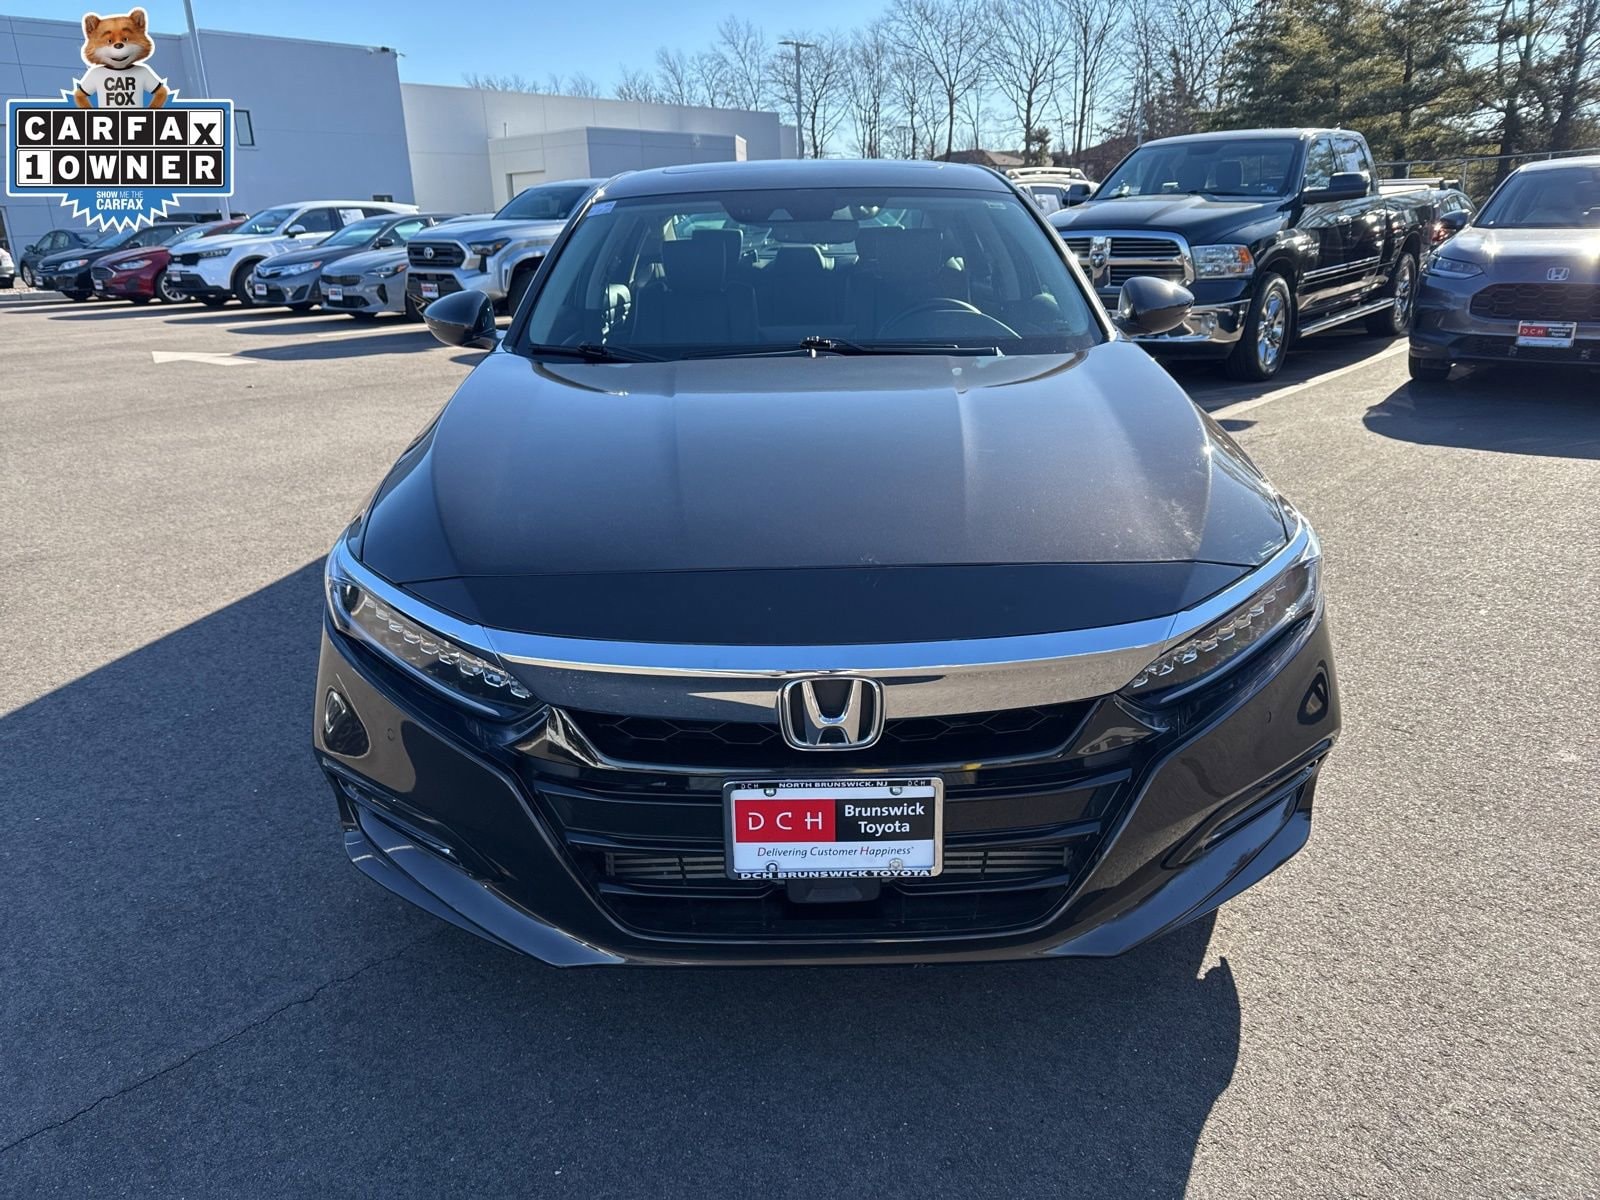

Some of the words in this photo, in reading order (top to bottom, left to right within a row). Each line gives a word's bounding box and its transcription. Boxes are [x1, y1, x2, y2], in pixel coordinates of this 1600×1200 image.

[844, 802, 925, 817] Brunswick
[858, 820, 910, 837] Toyota
[757, 847, 808, 859] Delivering
[810, 846, 857, 857] Customer
[740, 871, 774, 880] DCH
[777, 870, 871, 879] BRUNSWICK
[872, 869, 930, 878] TOYOTA
